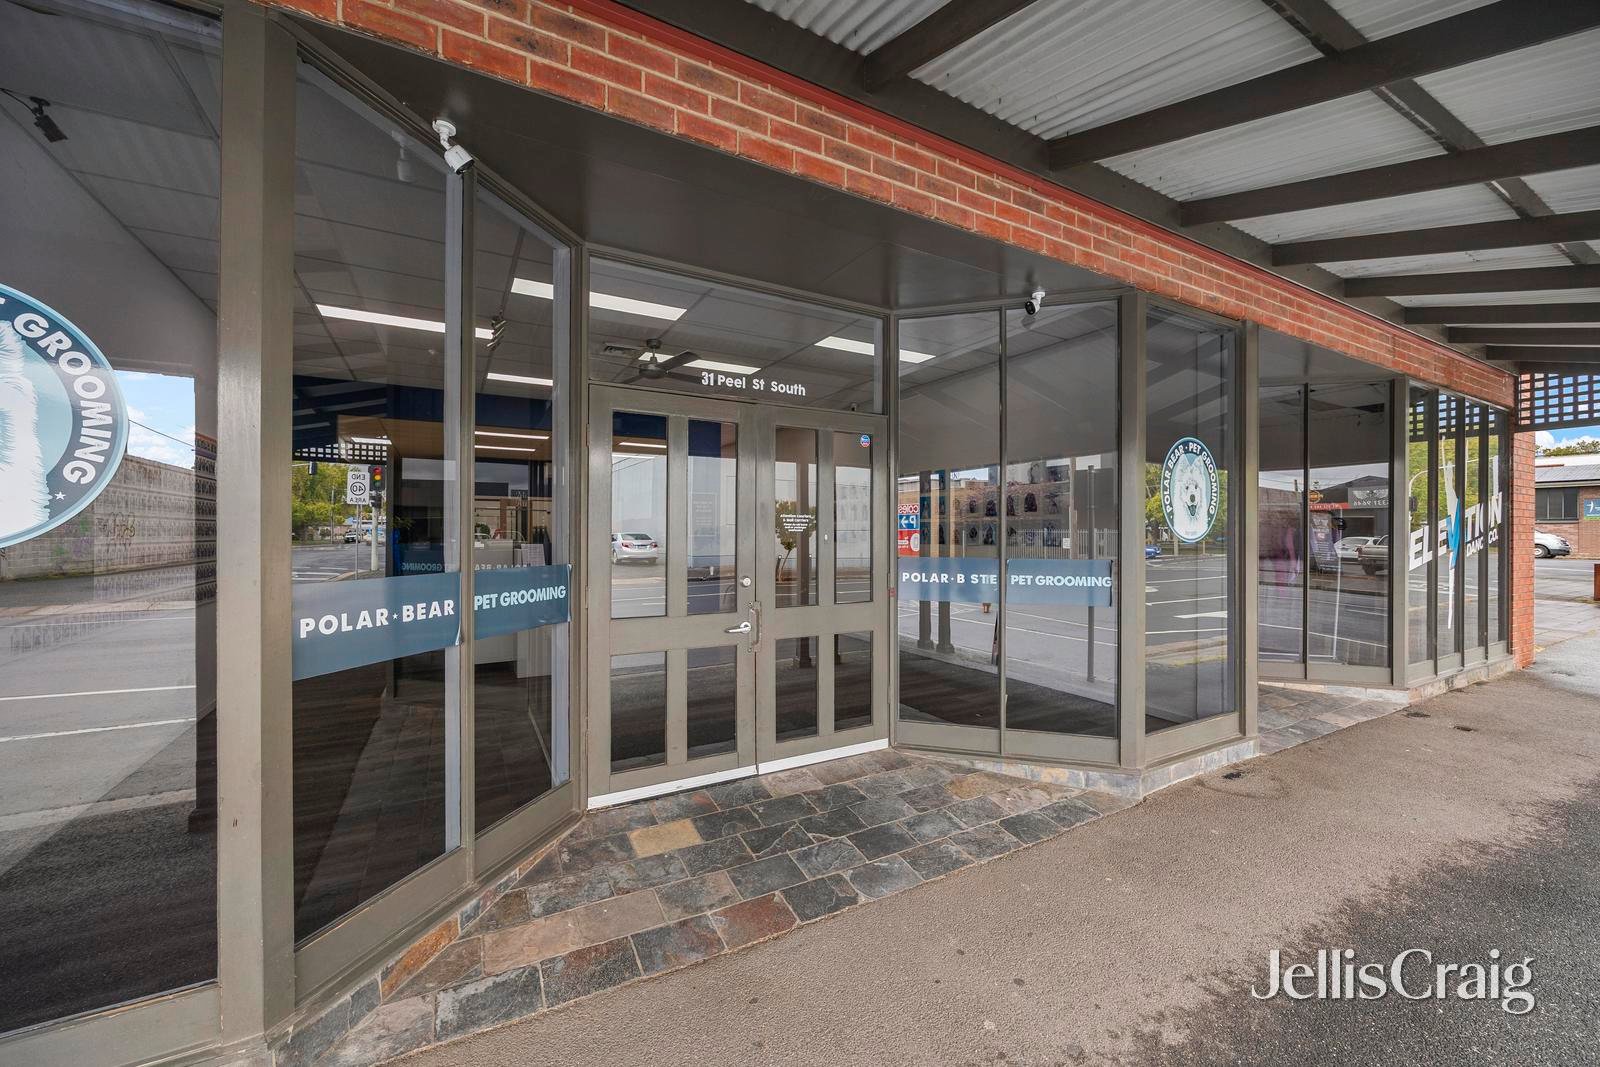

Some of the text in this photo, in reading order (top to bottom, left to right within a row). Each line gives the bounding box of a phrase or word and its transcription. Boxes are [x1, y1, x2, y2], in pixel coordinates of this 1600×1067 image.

[701, 371, 807, 396] 31 Peel St South
[13, 311, 114, 486] GROOMING
[1163, 441, 1218, 515] POLAR BEAR PET GROOMING
[902, 572, 949, 584] POLAR
[1010, 574, 1113, 587] PET GROOMING
[474, 585, 567, 611] PET GROOMING
[299, 599, 455, 639] POLAR BEAR
